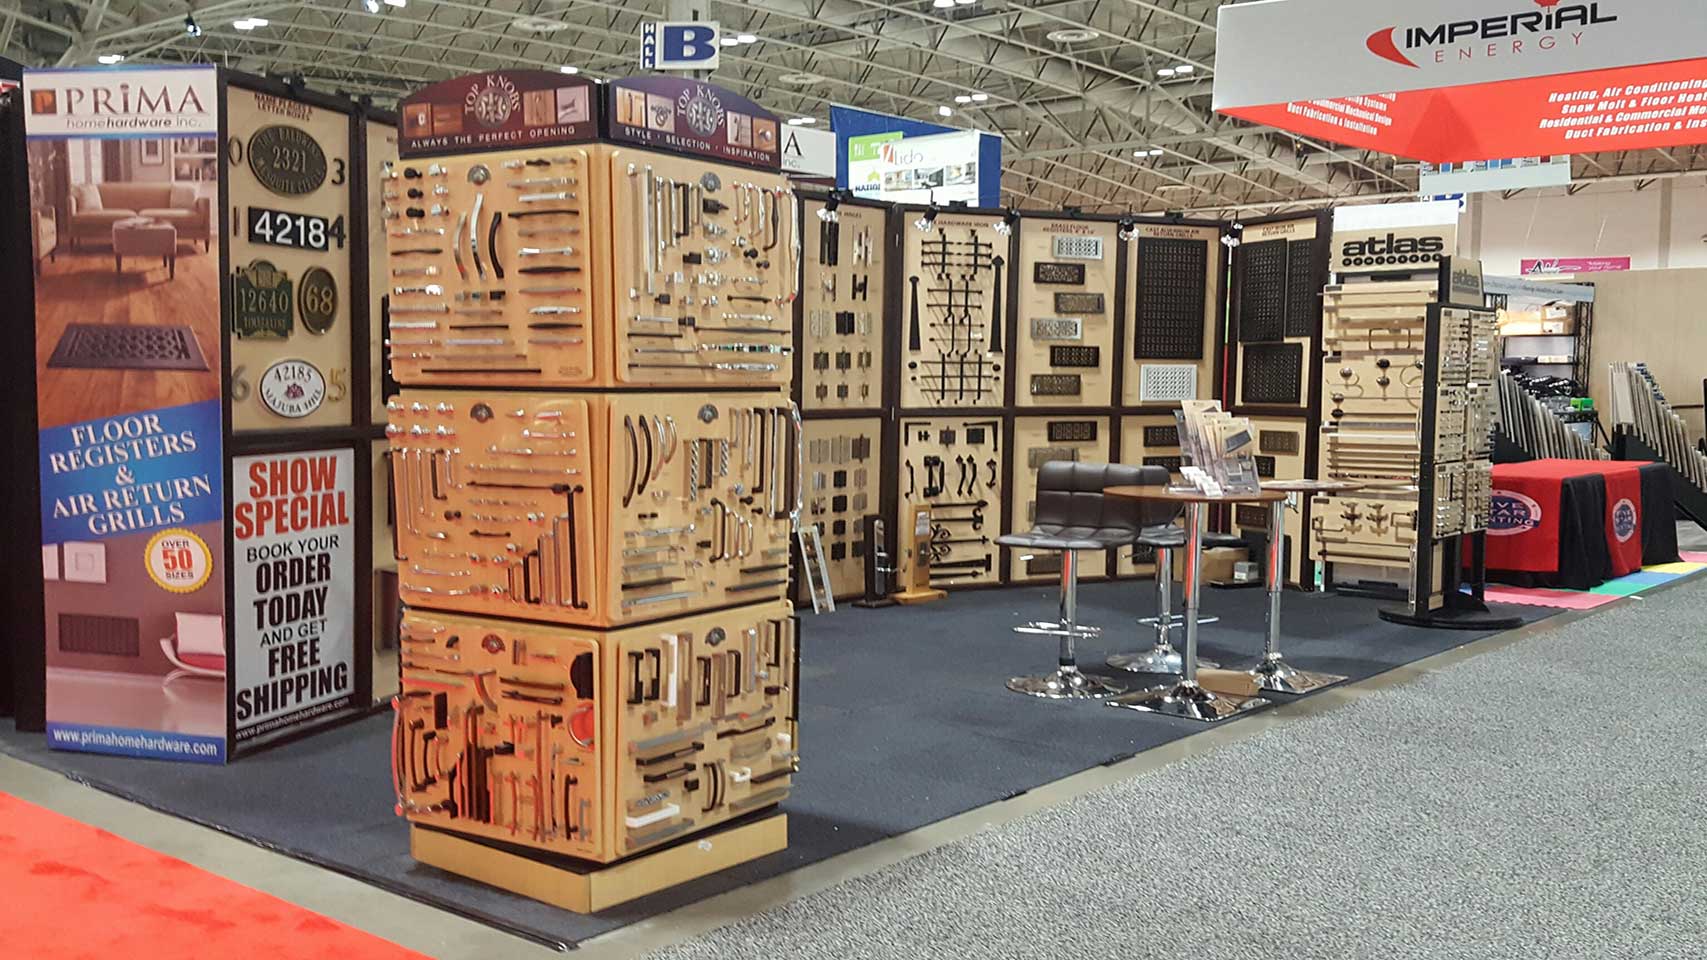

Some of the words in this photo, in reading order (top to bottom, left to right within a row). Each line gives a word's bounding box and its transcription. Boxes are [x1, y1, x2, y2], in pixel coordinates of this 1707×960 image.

[644, 23, 655, 68] HALL
[664, 26, 716, 61] B
[1435, 32, 1583, 63] ENERGY
[464, 83, 480, 115] TOP
[486, 74, 521, 112] KNOBS
[677, 88, 691, 117] TOP
[696, 84, 726, 128] KNOBS
[1561, 102, 1595, 114] Snow
[1597, 99, 1625, 111] Melt
[1628, 99, 1637, 108] &
[1640, 94, 1675, 107] Floor
[1602, 86, 1623, 98] Air
[1287, 102, 1303, 115] Duct
[1303, 106, 1339, 125] Fabrication
[1539, 114, 1604, 129] Residential
[1604, 114, 1614, 123] &
[1615, 106, 1687, 122] Commercial
[411, 137, 448, 149] ALWAYS
[455, 135, 472, 144] THE
[479, 129, 523, 143] PERFECT
[530, 125, 576, 138] OPENING
[624, 127, 652, 140] STYLE
[665, 135, 711, 151] SELECTION
[722, 147, 770, 162] INSPIRATION
[1565, 128, 1595, 140] Duct
[1597, 121, 1670, 136] Fabrication
[1673, 121, 1682, 130] &
[272, 145, 306, 173] 2321
[331, 157, 346, 185] 3
[254, 211, 326, 249] 4218
[328, 215, 346, 249] 4
[1342, 233, 1444, 257] atlas
[1452, 269, 1479, 288] atlas
[240, 288, 289, 313] 12640
[306, 286, 333, 316] 68
[231, 364, 250, 402] 6
[273, 365, 312, 384] 42185
[70, 413, 165, 449] FLOOR
[49, 431, 197, 475] REGISTERS
[114, 464, 136, 486] &
[248, 455, 338, 499] SHOW
[53, 494, 98, 520] AIR
[103, 474, 212, 512] RETURN
[87, 501, 187, 536] GRILLS
[234, 490, 350, 541] SPECIAL
[160, 539, 190, 549] OVER
[246, 540, 294, 562] BOOK
[298, 534, 340, 553] YOUR
[161, 548, 194, 571] 50
[255, 553, 332, 593] ORDER
[164, 570, 194, 580] SIZES
[253, 586, 329, 630] TODAY
[260, 627, 295, 647] AND
[298, 619, 328, 639] GET
[268, 637, 321, 678] FREE
[236, 661, 348, 721] SHIPPING
[53, 729, 218, 757] www.primahomehardware.com
